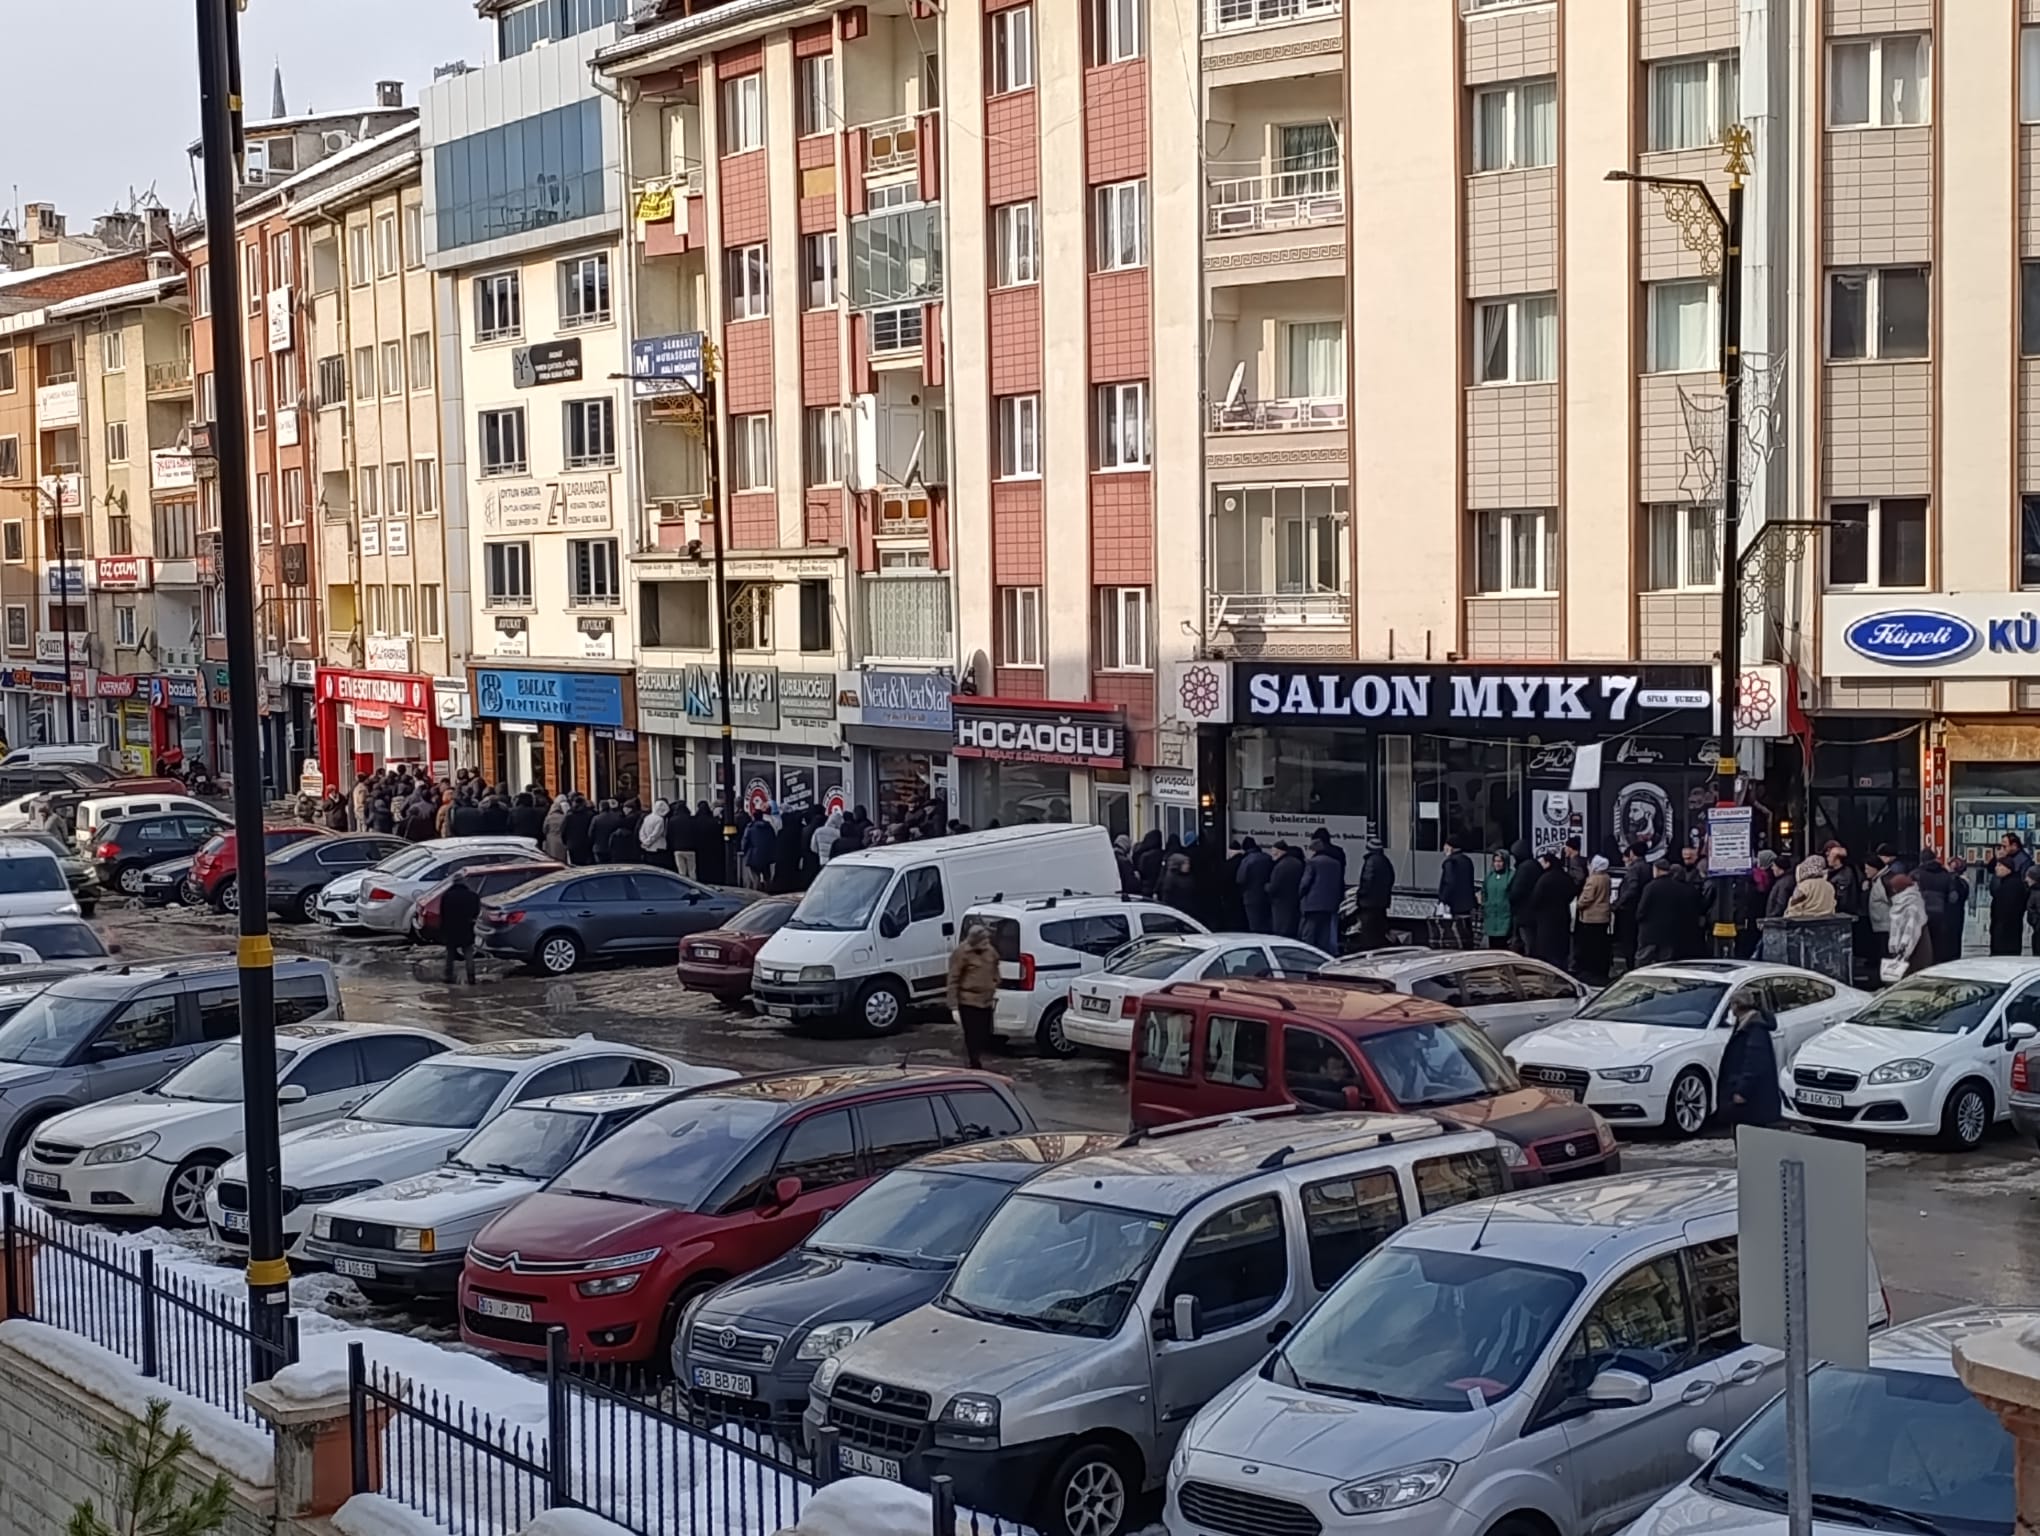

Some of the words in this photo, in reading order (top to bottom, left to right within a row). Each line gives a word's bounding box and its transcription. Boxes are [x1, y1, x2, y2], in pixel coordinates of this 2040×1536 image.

[1868, 623, 1953, 649] Küpeli
[1250, 673, 1431, 717] SALON
[1450, 675, 1592, 719] MYK
[1601, 675, 1638, 721] 7
[958, 715, 1115, 756] HOCAOĞLU
[1154, 774, 1196, 788] ÇAVUŞOĞLU
[1269, 814, 1326, 825] Şubelerimiz
[515, 1304, 530, 1321] 724
[699, 1370, 711, 1386] 58
[714, 1371, 730, 1389] BB
[730, 1375, 750, 1393] 780
[842, 1449, 855, 1466] 58
[879, 1459, 898, 1479] 799
